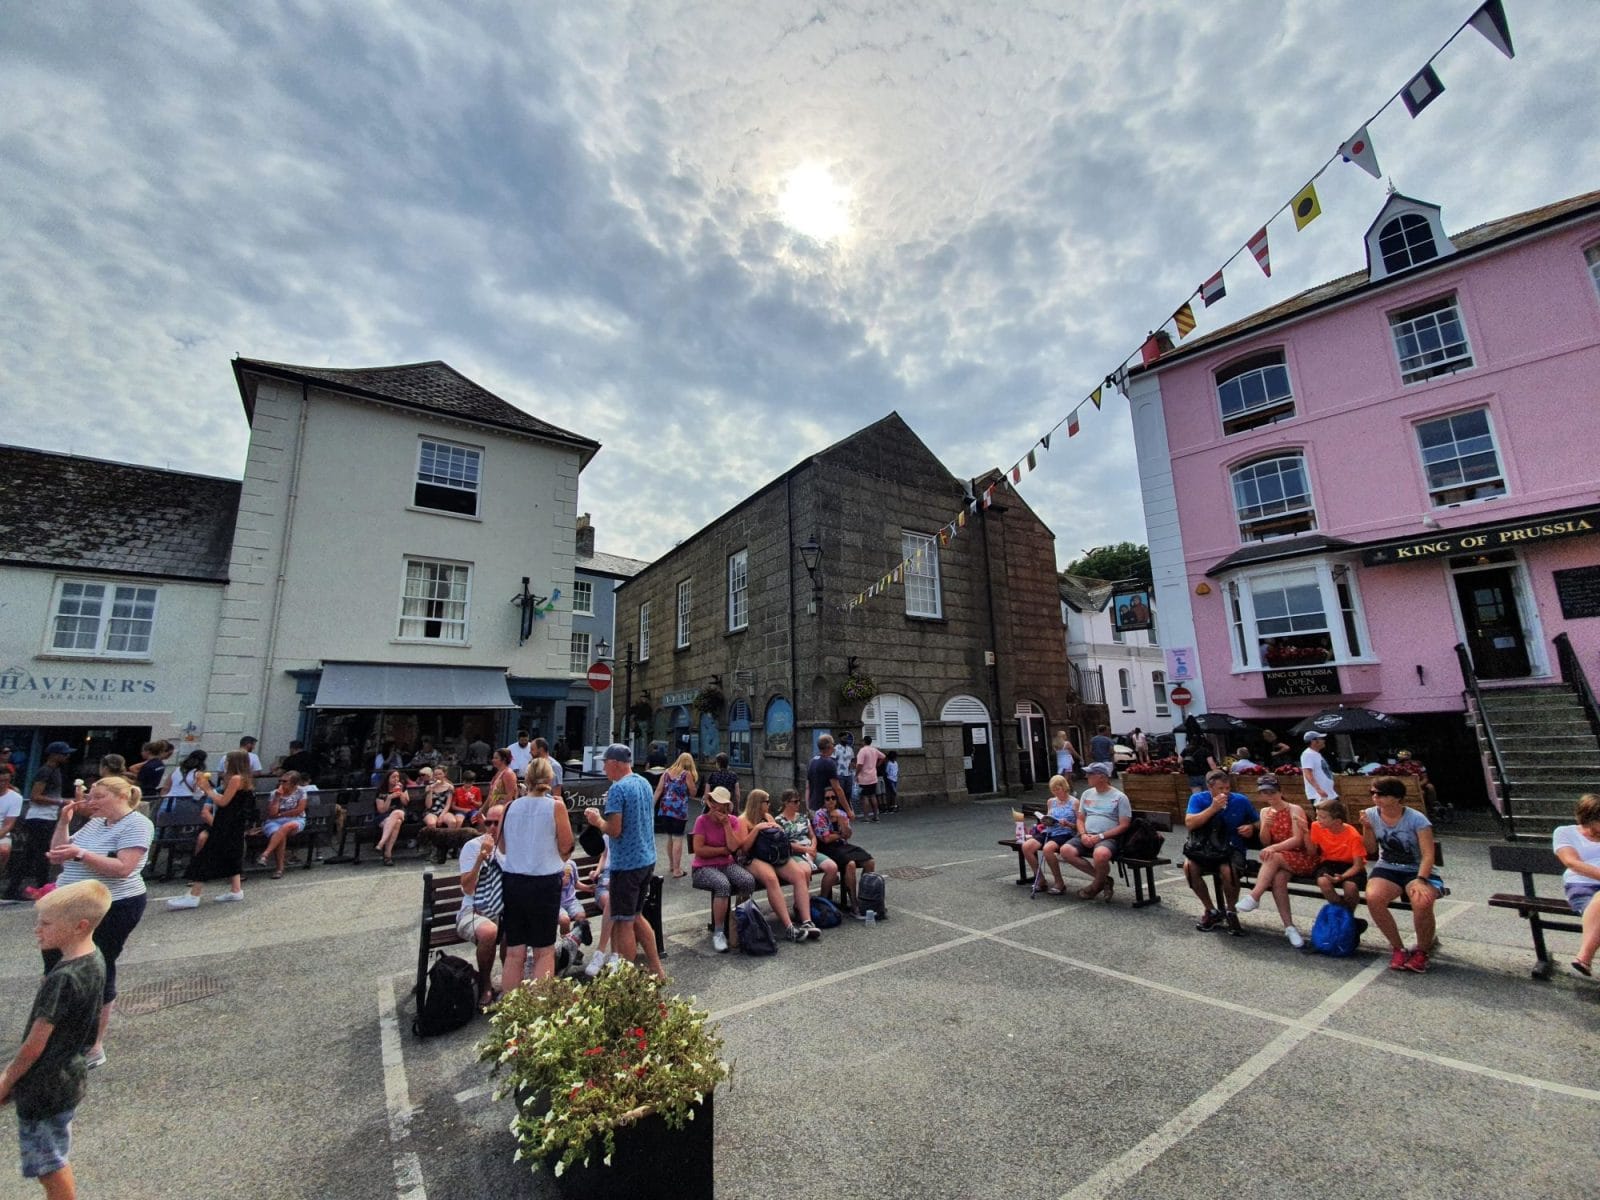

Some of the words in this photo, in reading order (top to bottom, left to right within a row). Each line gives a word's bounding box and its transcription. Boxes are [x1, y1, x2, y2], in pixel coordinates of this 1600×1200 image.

[1397, 541, 1450, 558] KING
[1460, 535, 1488, 549] OF
[1500, 519, 1593, 543] PRUSSIA
[1300, 668, 1333, 676] PRUSSIA
[0, 675, 156, 693] HAVENER'S
[1286, 678, 1315, 686] OPEN
[1277, 687, 1297, 695] ALL
[1299, 684, 1328, 694] YEAR
